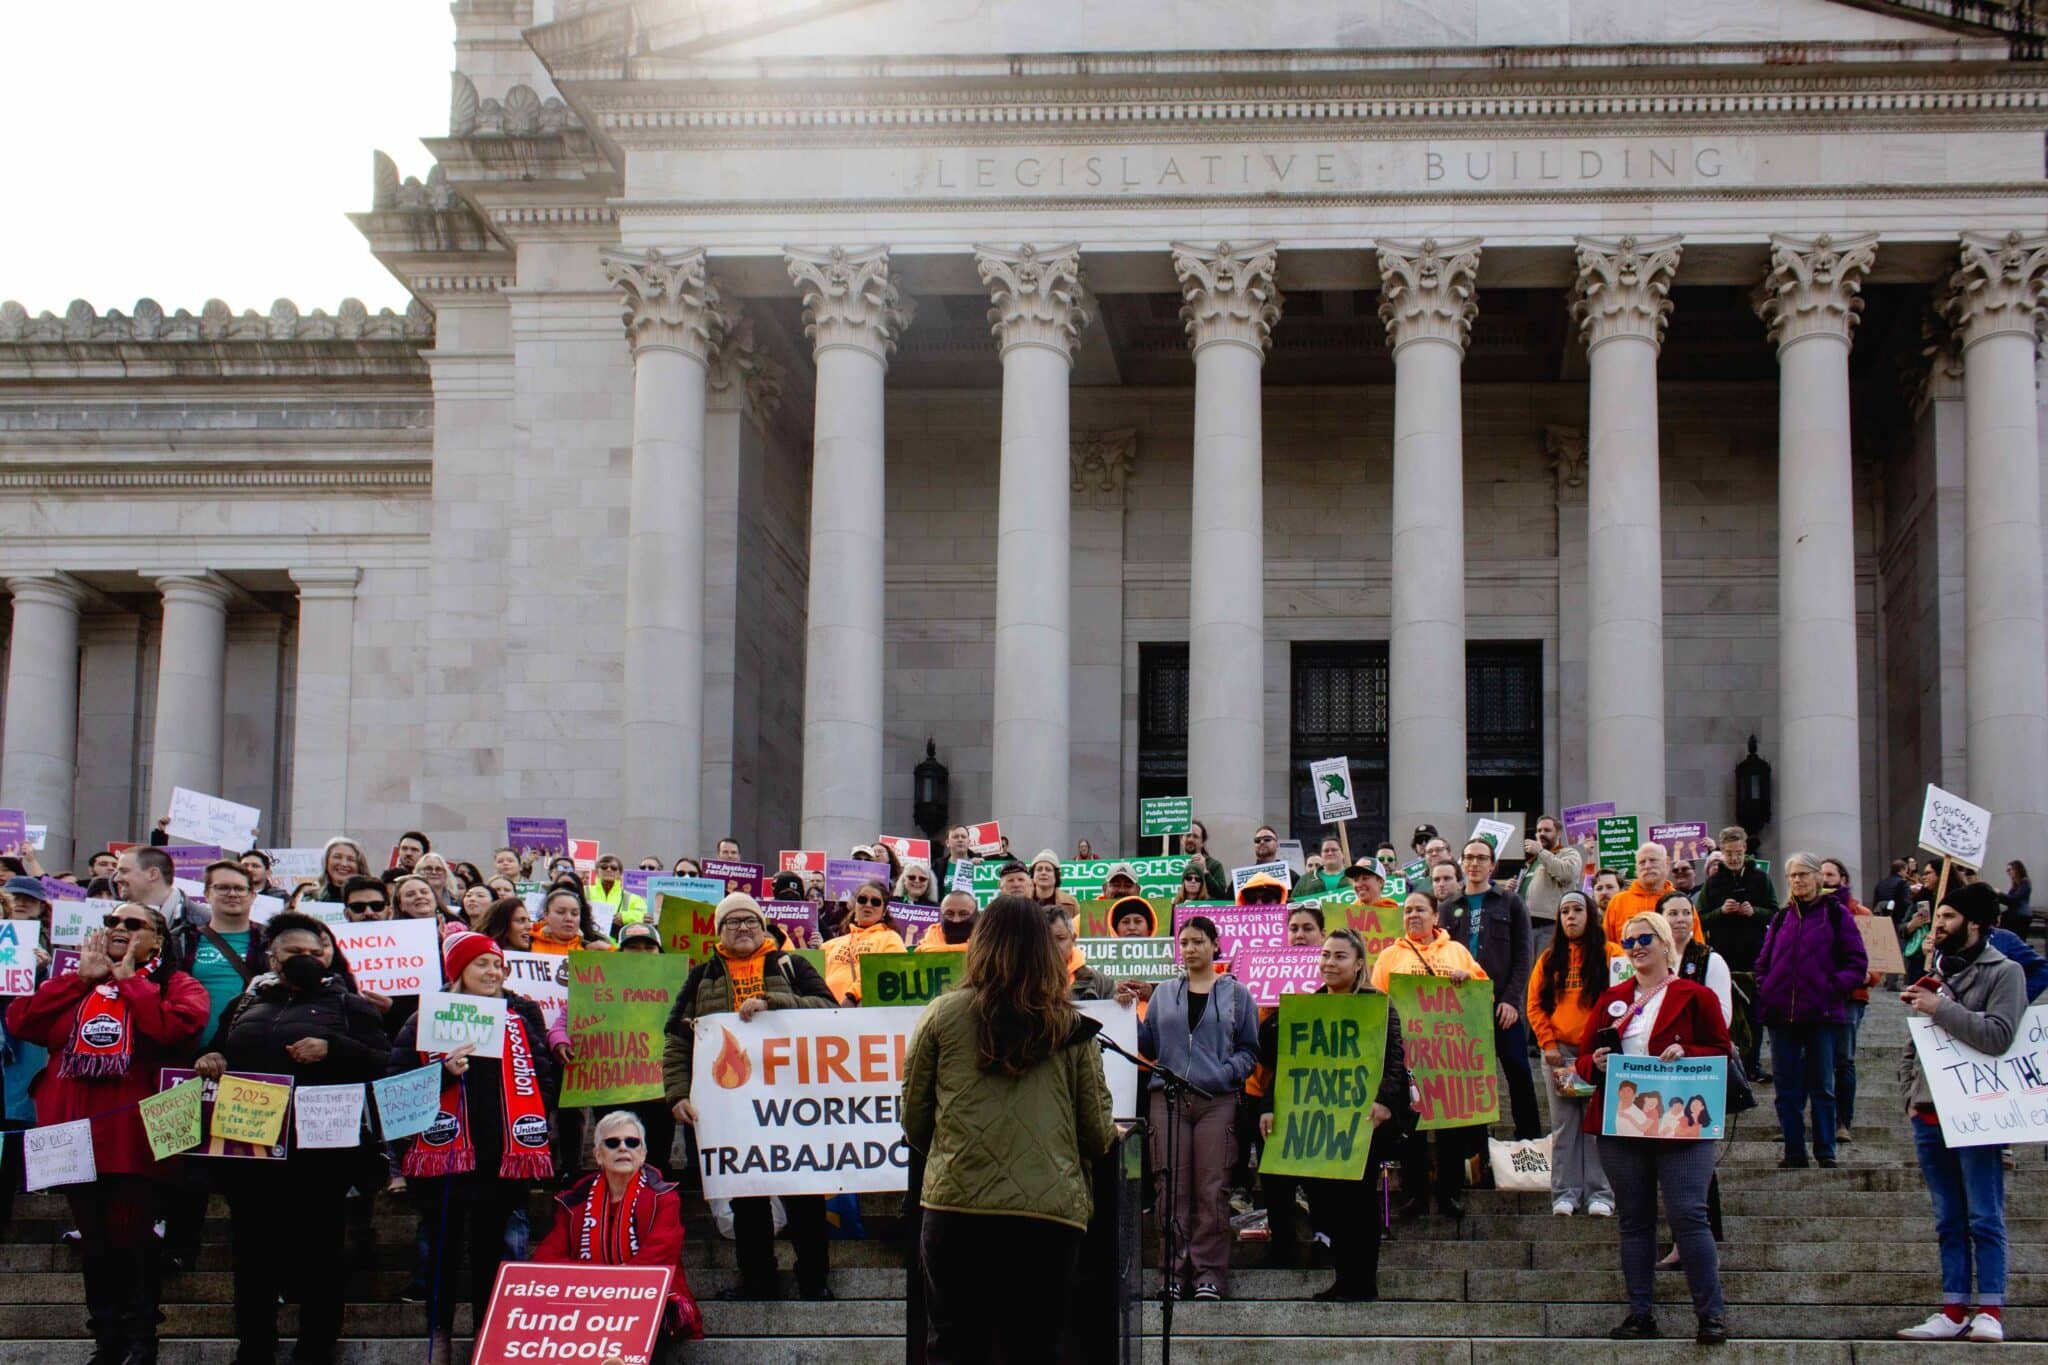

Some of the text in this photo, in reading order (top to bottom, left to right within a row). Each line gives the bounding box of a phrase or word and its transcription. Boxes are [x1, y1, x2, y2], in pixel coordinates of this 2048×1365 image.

[936, 148, 1723, 188] LEGISLATIVE BUILDING
[766, 904, 801, 915] justice
[777, 911, 809, 920] justice
[1242, 914, 1262, 922] FOR
[1265, 913, 1284, 921] THE
[1345, 906, 1382, 933] WA
[1088, 908, 1108, 937] W
[1216, 922, 1284, 937] ORKING
[0, 922, 19, 946] A
[336, 935, 397, 950] ANCIA
[672, 934, 690, 951] IS
[349, 955, 424, 973] UESTRO
[525, 959, 552, 982] THE
[1103, 963, 1185, 977] BILLIONAIRES
[1251, 956, 1276, 965] KICK
[1277, 956, 1297, 964] ASS
[575, 965, 606, 985] WA
[1250, 965, 1322, 979] WORKIN
[594, 988, 614, 1003] ES
[1246, 980, 1323, 1000] CLAS
[1415, 985, 1464, 1014] WA
[434, 1010, 495, 1026] CHILD CARE
[449, 1002, 478, 1014] FUND
[432, 1020, 495, 1046] NOW
[1289, 1017, 1361, 1059] FAIR
[1407, 1018, 1469, 1038] IS FOR
[570, 1031, 651, 1061] FAMILIAS
[1622, 1062, 1713, 1073] Fund the People
[1942, 1051, 2048, 1096] TAX THE
[231, 1086, 271, 1106] 2025
[1288, 1064, 1370, 1109] TAXES
[1410, 1073, 1498, 1122] AMILIES
[1951, 1111, 1991, 1134] we
[1993, 1099, 2028, 1130] will
[423, 1120, 458, 1134] nited!
[1281, 1109, 1362, 1161] NOW
[153, 1130, 175, 1147] FOR
[701, 1139, 909, 1177] TRABAJADO
[504, 1280, 658, 1300] raise revenue
[506, 1307, 640, 1332] fund our
[503, 1336, 623, 1360] schools
[624, 1355, 647, 1364] WEA
